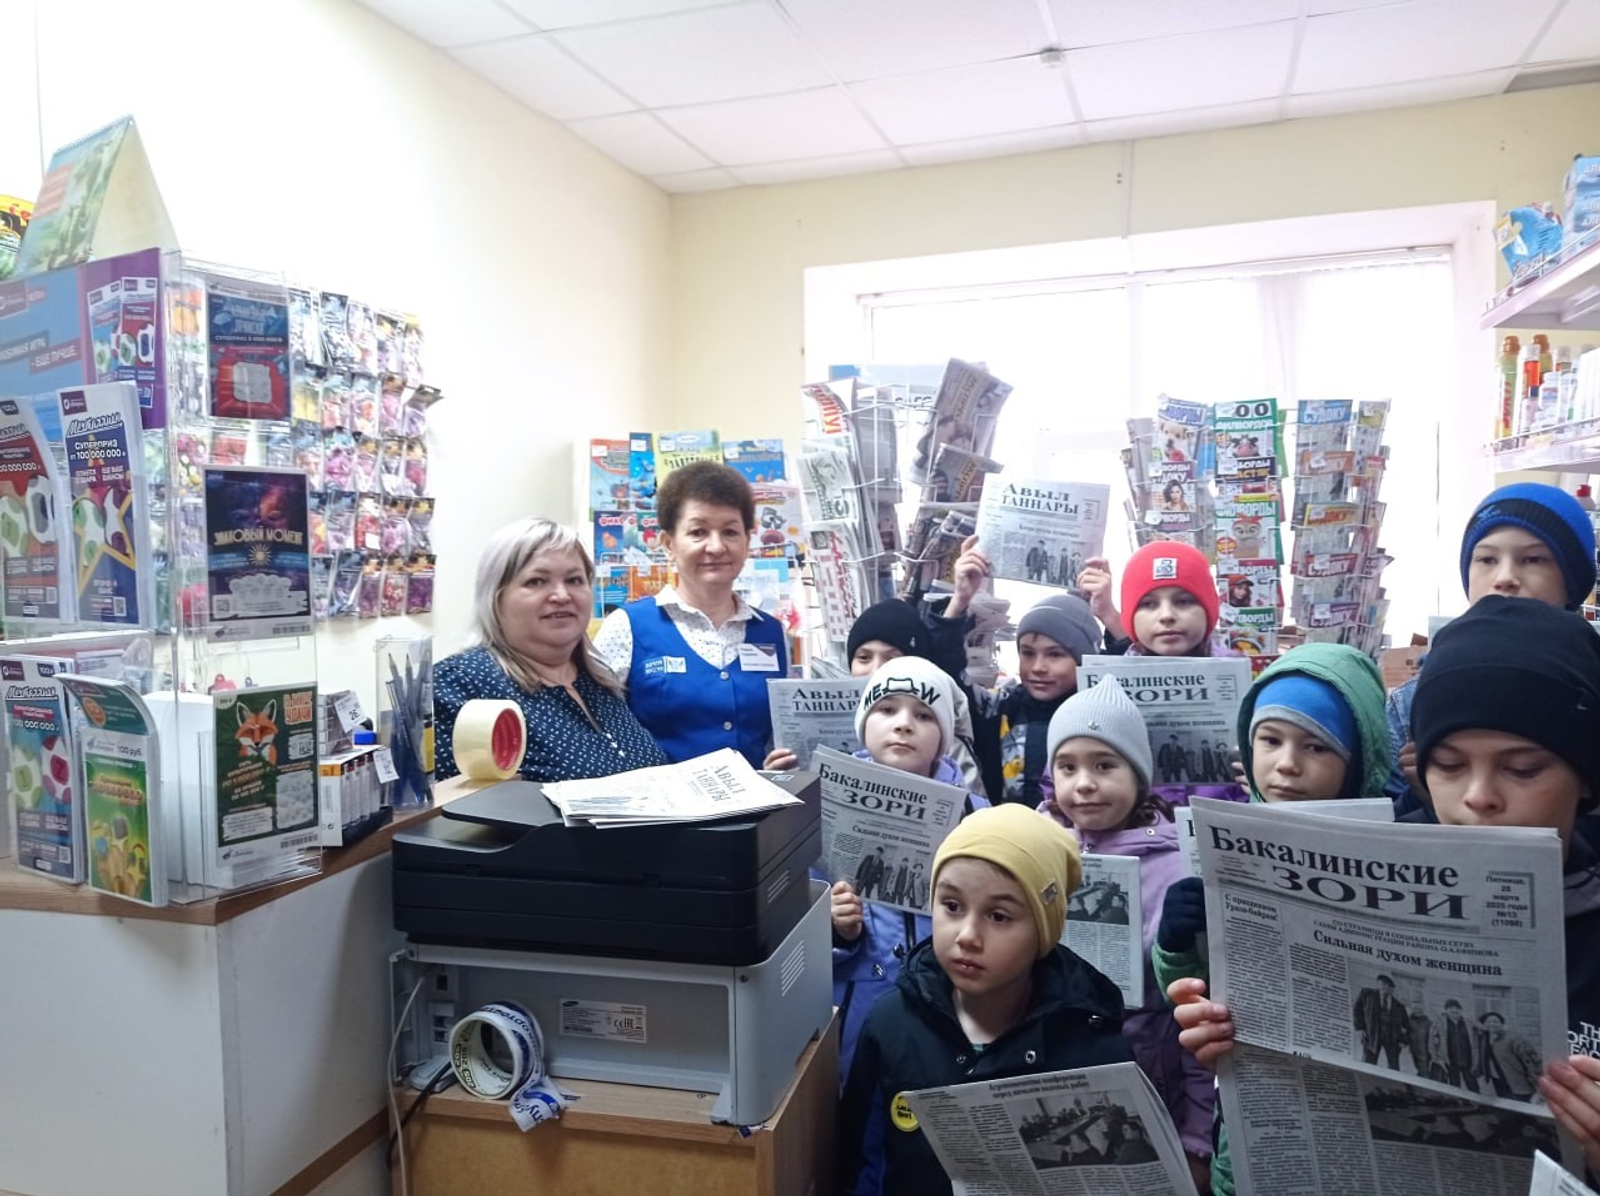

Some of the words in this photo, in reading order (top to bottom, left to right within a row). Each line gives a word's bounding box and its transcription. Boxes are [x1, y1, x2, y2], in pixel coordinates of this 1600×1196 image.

[75, 439, 118, 450] СУПЕРПРИЗ
[1087, 674, 1205, 688] Балинские
[820, 763, 928, 804] Бакалинские
[841, 789, 927, 820] ЗОРИ
[1207, 824, 1459, 887] Бакалинские
[1272, 864, 1470, 920] ЗОРИ
[1313, 929, 1373, 955] Сильная
[1376, 948, 1421, 967] духом
[1425, 957, 1503, 977] женщина
